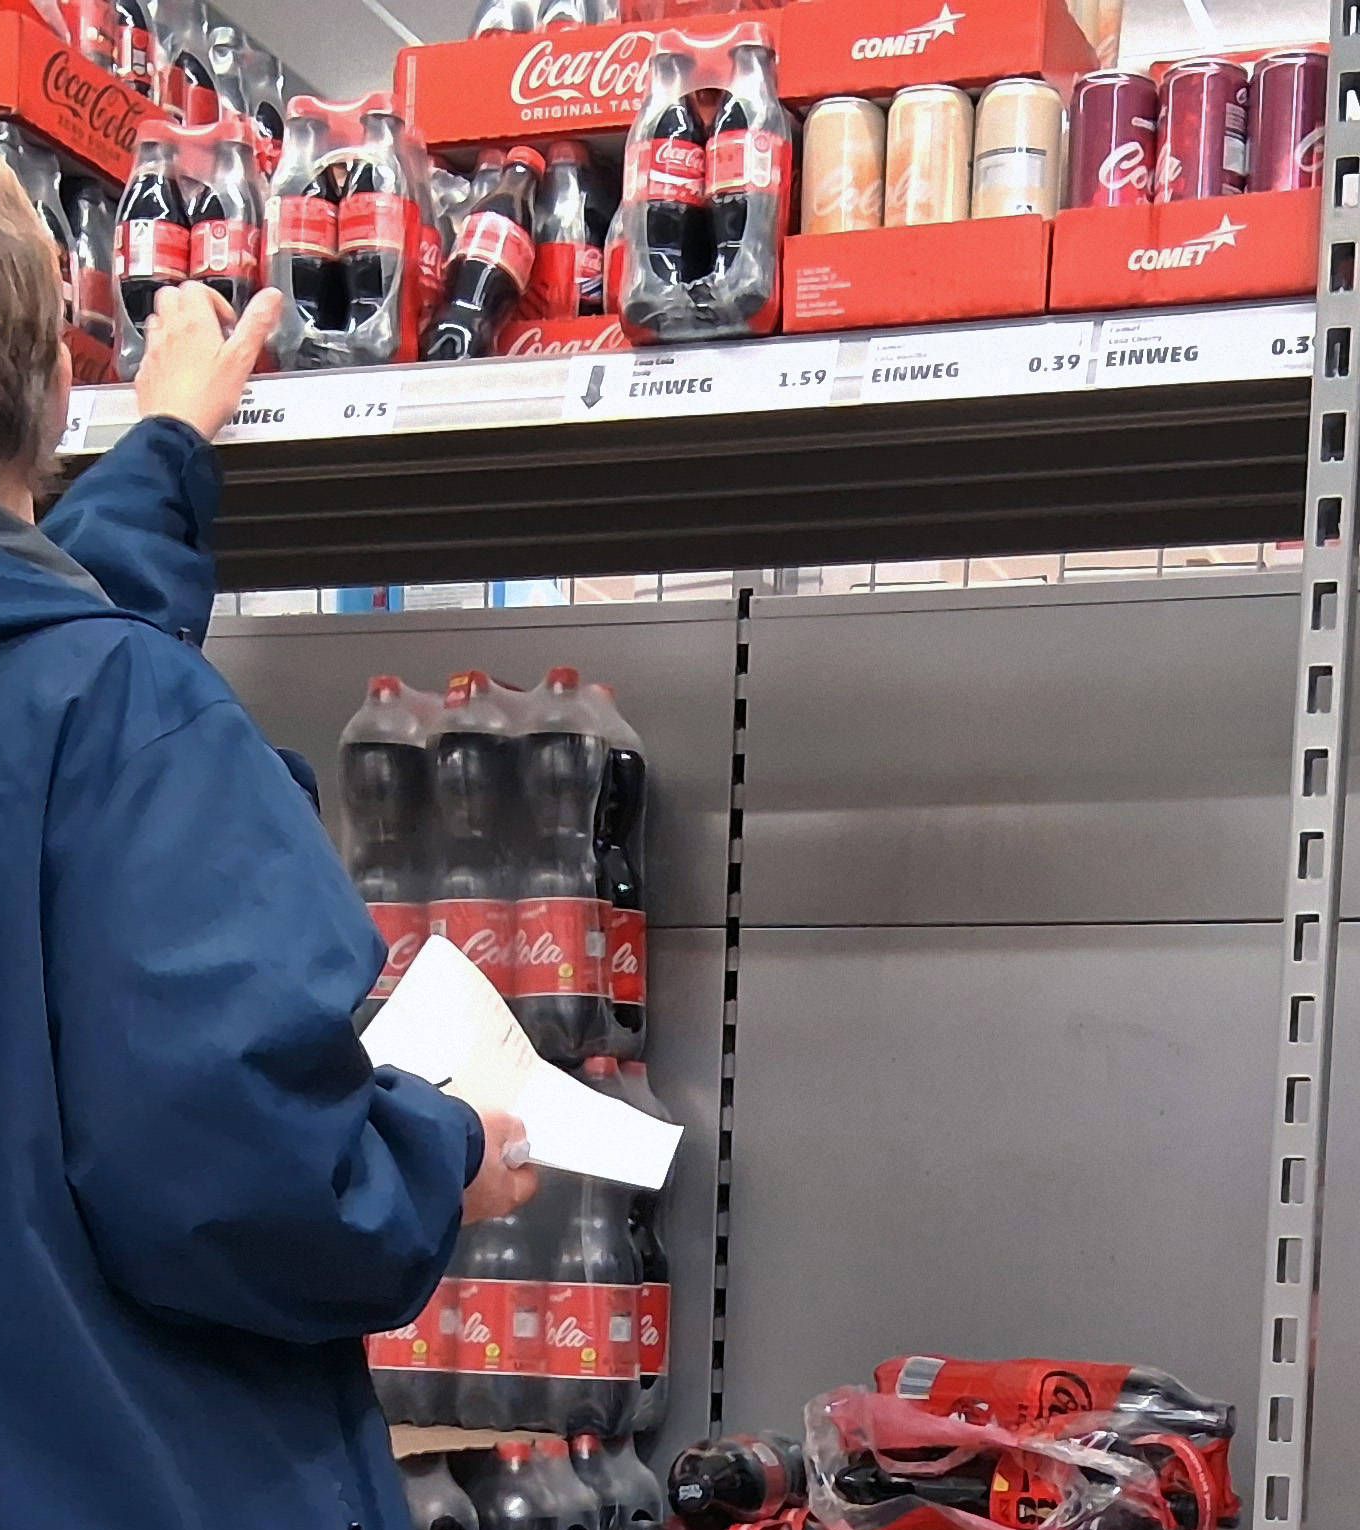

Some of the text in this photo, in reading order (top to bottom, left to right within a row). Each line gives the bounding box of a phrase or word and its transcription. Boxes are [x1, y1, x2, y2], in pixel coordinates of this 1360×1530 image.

[851, 30, 934, 60] COMET
[511, 31, 656, 105] Coca-Col
[521, 100, 642, 120] ORIGINAL TAS
[1127, 245, 1213, 271] COMET
[1106, 335, 1311, 367] EINWEG 0.3
[872, 354, 1081, 383] EINWEG 0.39
[629, 369, 827, 397] EINWEG 1.59
[227, 402, 388, 425] NWEG 0.75
